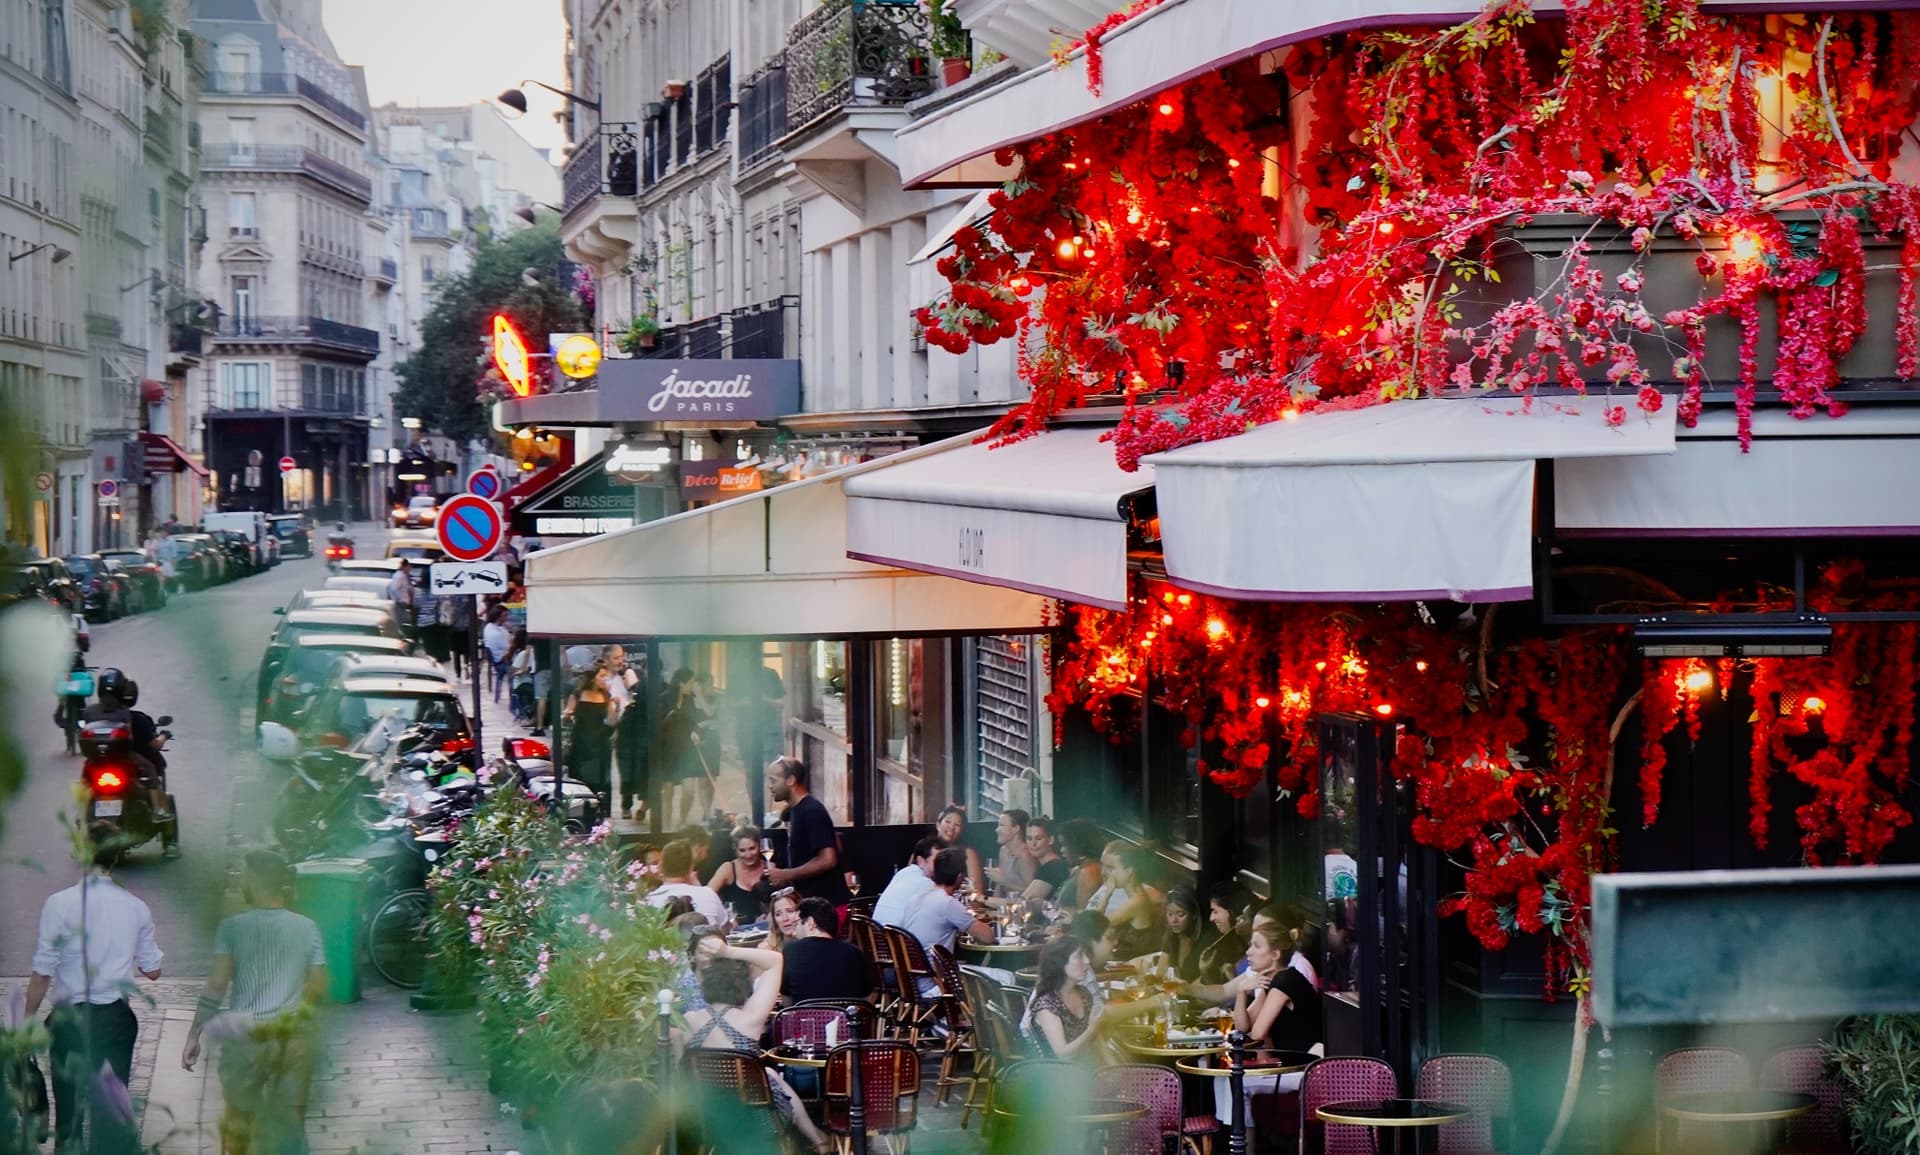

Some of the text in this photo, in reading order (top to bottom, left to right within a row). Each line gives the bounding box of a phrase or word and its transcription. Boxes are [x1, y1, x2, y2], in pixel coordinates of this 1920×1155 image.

[648, 368, 752, 412] jacadi
[677, 402, 734, 412] PARIS
[685, 470, 757, 488] Déco Relief
[563, 495, 635, 508] BRASSERIE
